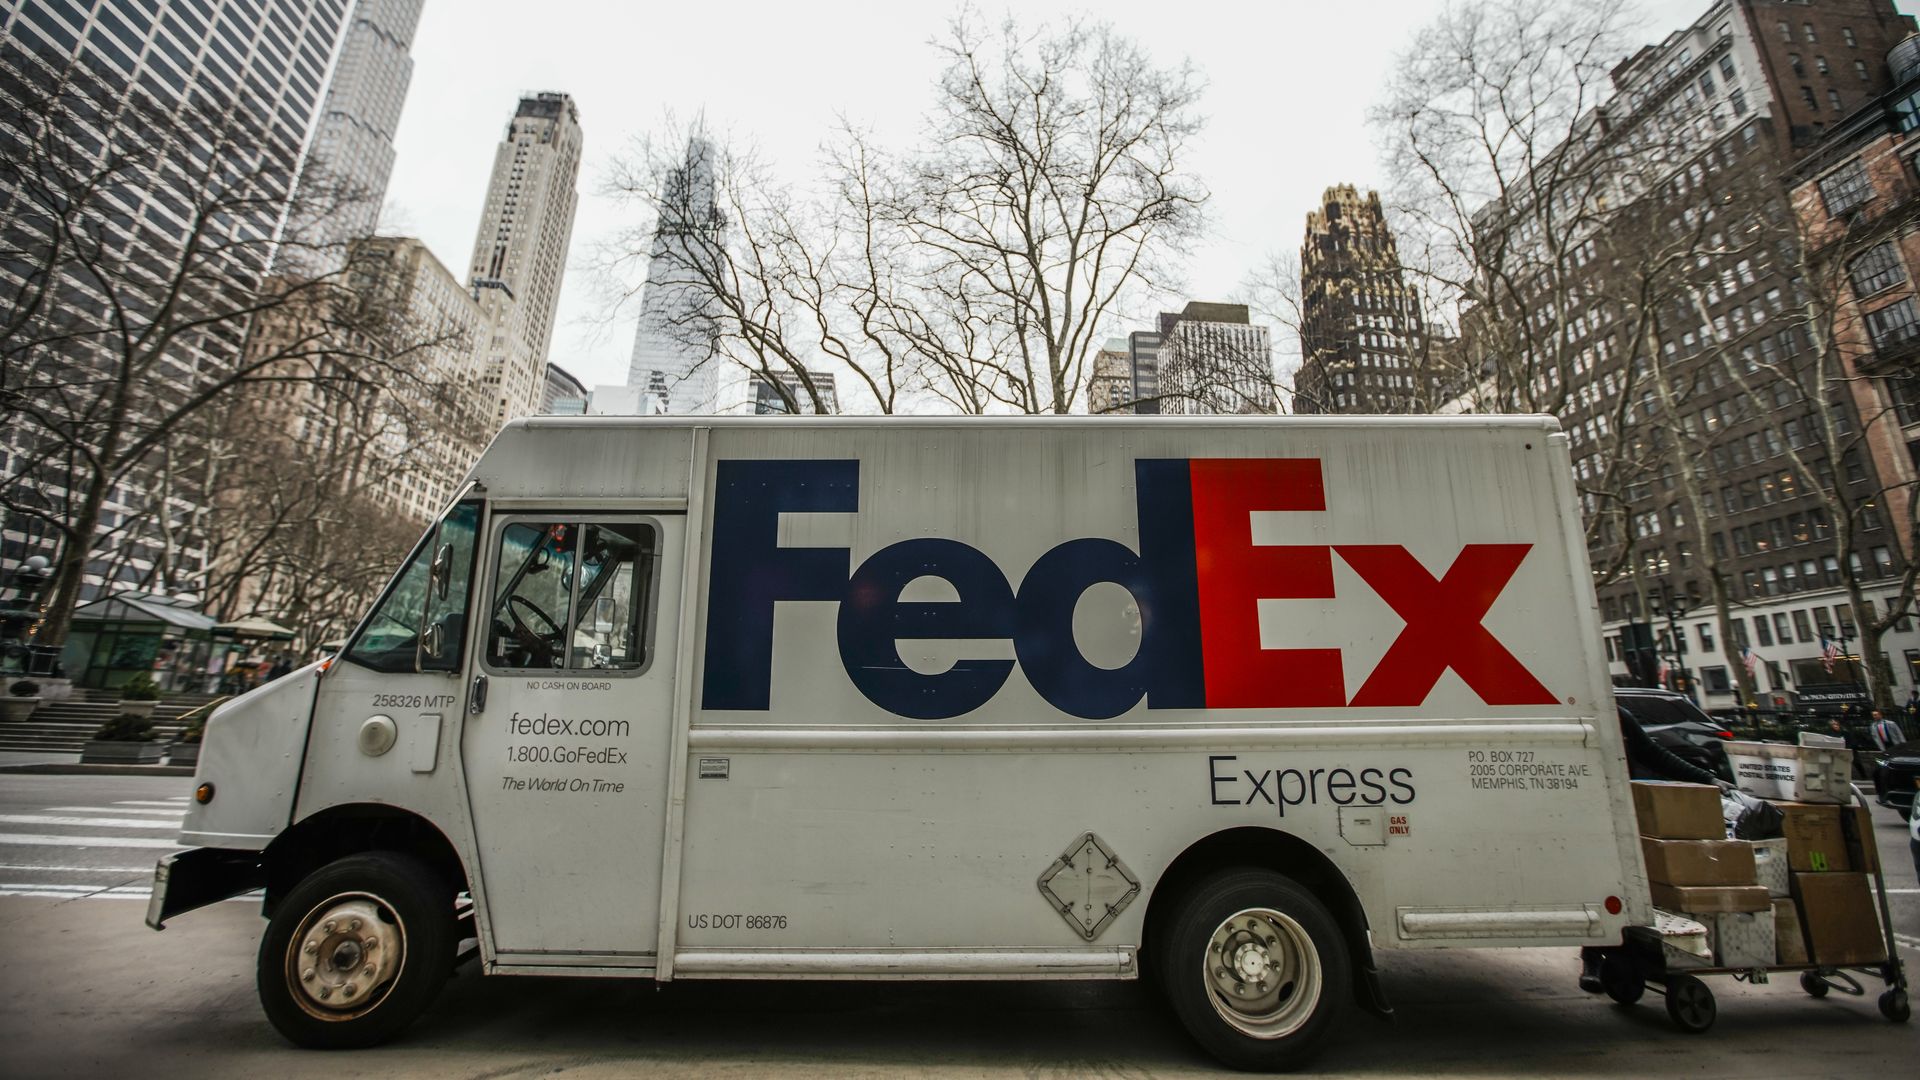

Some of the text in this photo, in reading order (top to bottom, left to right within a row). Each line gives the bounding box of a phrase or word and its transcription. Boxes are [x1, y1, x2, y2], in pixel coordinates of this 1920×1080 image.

[701, 458, 1562, 720] FedEx
[526, 681, 612, 691] NO CASH ON BOARD
[372, 694, 456, 708] 258326 MTP
[509, 712, 630, 737] fedex.com
[506, 746, 628, 764] 1.800.GoFedEx
[1491, 751, 1513, 762] BOX
[1515, 751, 1534, 762] 727
[1470, 765, 1496, 776] 2005
[1498, 765, 1565, 776] CORPORATE
[1738, 763, 1791, 773] UNITED STATES
[1738, 771, 1796, 782] POSTAL SERVICE
[502, 776, 625, 793] The World On Time
[1208, 755, 1416, 818] Express
[1471, 777, 1579, 790] MEMPHIS, TN 38194
[1390, 816, 1407, 825] GAS
[1389, 826, 1409, 835] ONLY
[688, 914, 787, 929] US DOT 86876
